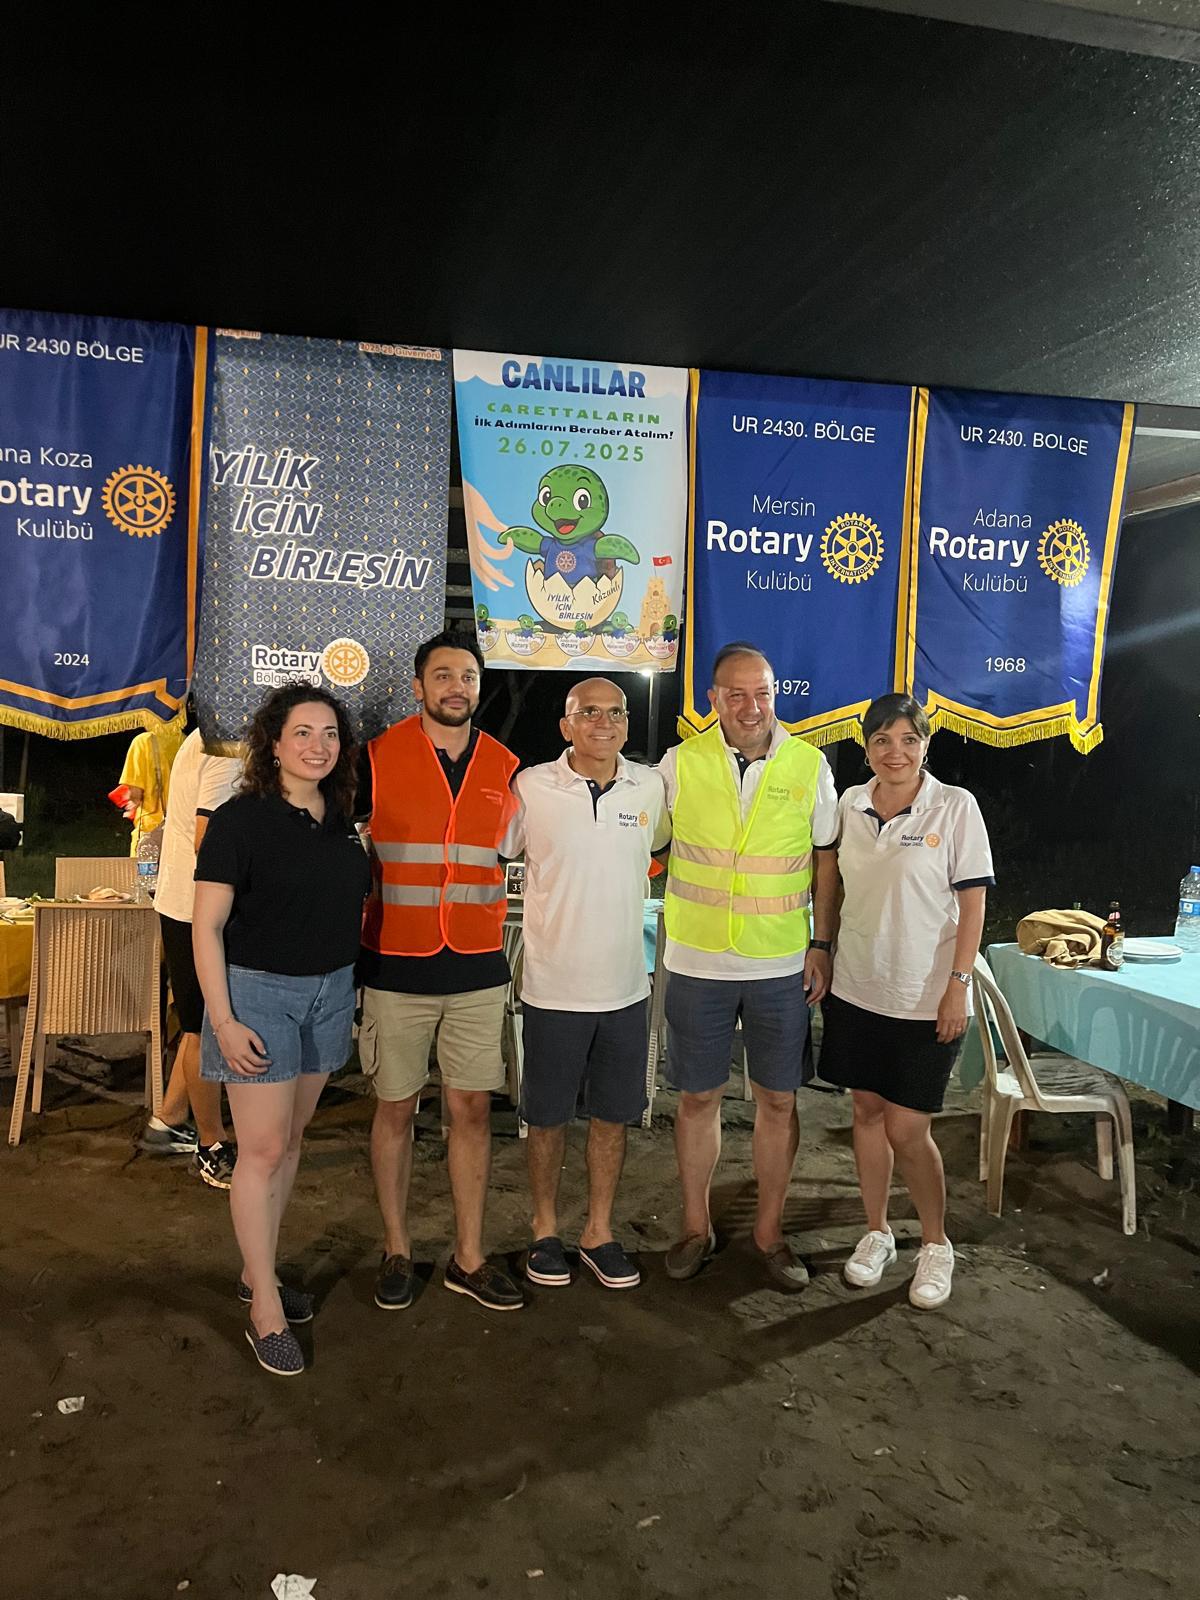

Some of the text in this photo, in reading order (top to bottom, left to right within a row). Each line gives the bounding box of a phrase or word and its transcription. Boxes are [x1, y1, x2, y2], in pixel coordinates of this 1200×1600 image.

[26, 337, 71, 356] 2430
[76, 341, 144, 363] BÖLGE
[502, 360, 646, 398] CANLILAR
[487, 402, 661, 424] CARETTALARIN
[474, 415, 674, 440] İlk Adımlarını Beraber Atalım!
[732, 415, 876, 443] UR 2430. BÖLGE
[960, 425, 983, 443] UR
[988, 429, 1026, 447] 2430.
[40, 446, 93, 468] Koza
[498, 437, 644, 462] 26.07.2025
[233, 492, 322, 538] İÇİN
[753, 495, 815, 516] Mersin
[17, 517, 93, 540] Kulübü
[841, 521, 867, 529] ROTARY
[973, 508, 1032, 528] Adana
[706, 520, 814, 562] Rotary
[929, 526, 1030, 568] Rotary
[250, 540, 432, 590] BİRLEŞİN
[830, 558, 875, 577] INTERNATIONAL
[747, 570, 812, 591] Kulübü
[963, 572, 1028, 593] Kulübü
[54, 653, 90, 666] 2024
[254, 647, 321, 672] Rotary
[985, 657, 1026, 673] 1968
[256, 672, 288, 686] Bölge
[774, 680, 810, 695] 1972
[619, 813, 638, 822] Rotary
